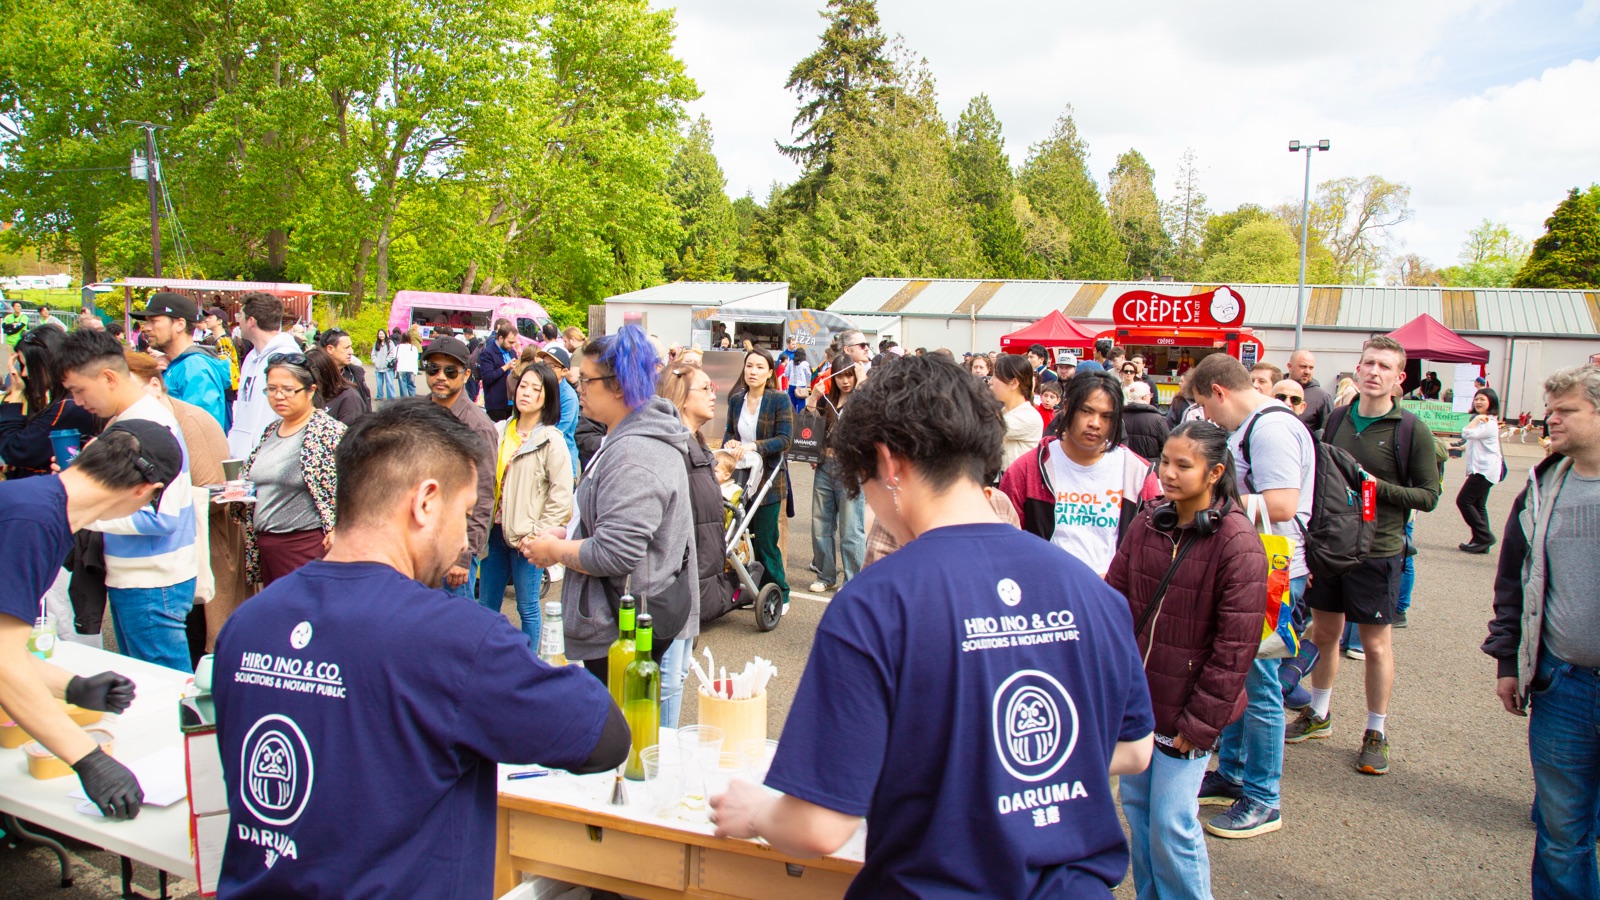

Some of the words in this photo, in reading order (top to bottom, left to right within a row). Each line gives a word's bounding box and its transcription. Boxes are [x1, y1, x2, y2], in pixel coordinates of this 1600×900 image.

[1122, 294, 1192, 322] CRÊPES
[1435, 412, 1460, 420] Kofta
[1056, 491, 1102, 504] HOOL
[1055, 502, 1098, 516] GITAL
[1056, 514, 1119, 528] AMPION
[1000, 615, 1028, 632] INO
[1032, 613, 1046, 629] &
[1010, 636, 1018, 646] &
[1017, 632, 1054, 646] NOTARY
[240, 651, 272, 670] HIRO
[274, 656, 302, 675] INO
[303, 660, 313, 677] &
[316, 662, 342, 682] CO.
[275, 677, 282, 688] &
[282, 679, 316, 693] NOTARY
[316, 684, 347, 699] PUBLIC
[998, 780, 1088, 815] DARUMA
